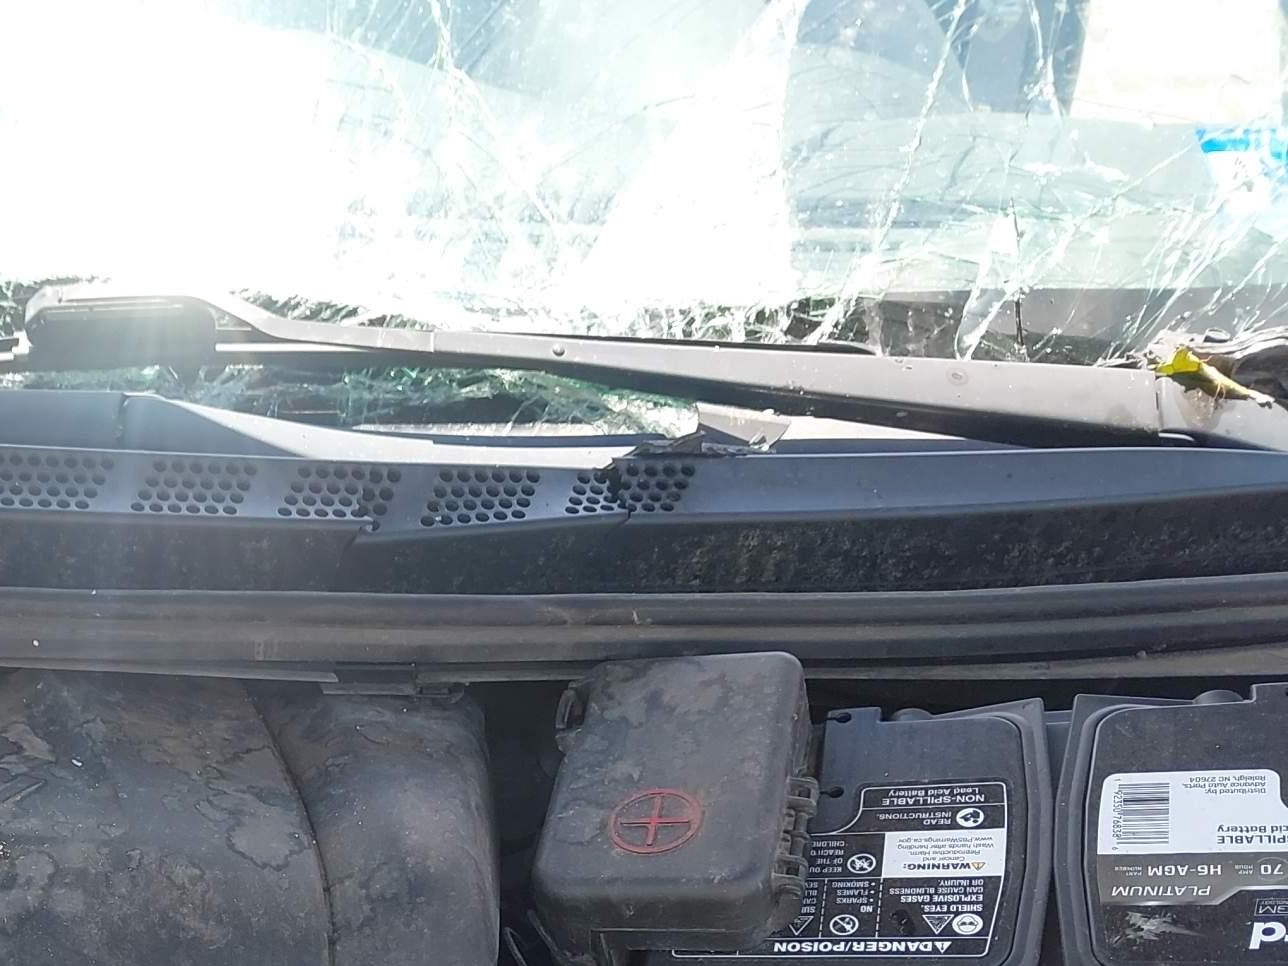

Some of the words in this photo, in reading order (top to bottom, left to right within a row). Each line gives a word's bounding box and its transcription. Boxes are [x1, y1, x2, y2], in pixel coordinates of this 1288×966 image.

[928, 788, 950, 796] Acid
[882, 794, 984, 805] NON-SPILLABLE
[1217, 824, 1266, 834] Battery
[1216, 835, 1288, 844] PILLABLE
[903, 862, 970, 870] WARNING:
[1147, 864, 1222, 876] H6-AGM
[1260, 864, 1284, 875] 70
[888, 887, 935, 895] BLINDNESS
[1111, 885, 1211, 896] PLATINUM
[900, 895, 930, 903] GASES
[932, 894, 984, 902] EXPLOSIVE
[950, 904, 983, 912] SHIELD
[773, 941, 933, 952] DANGER/POISON
